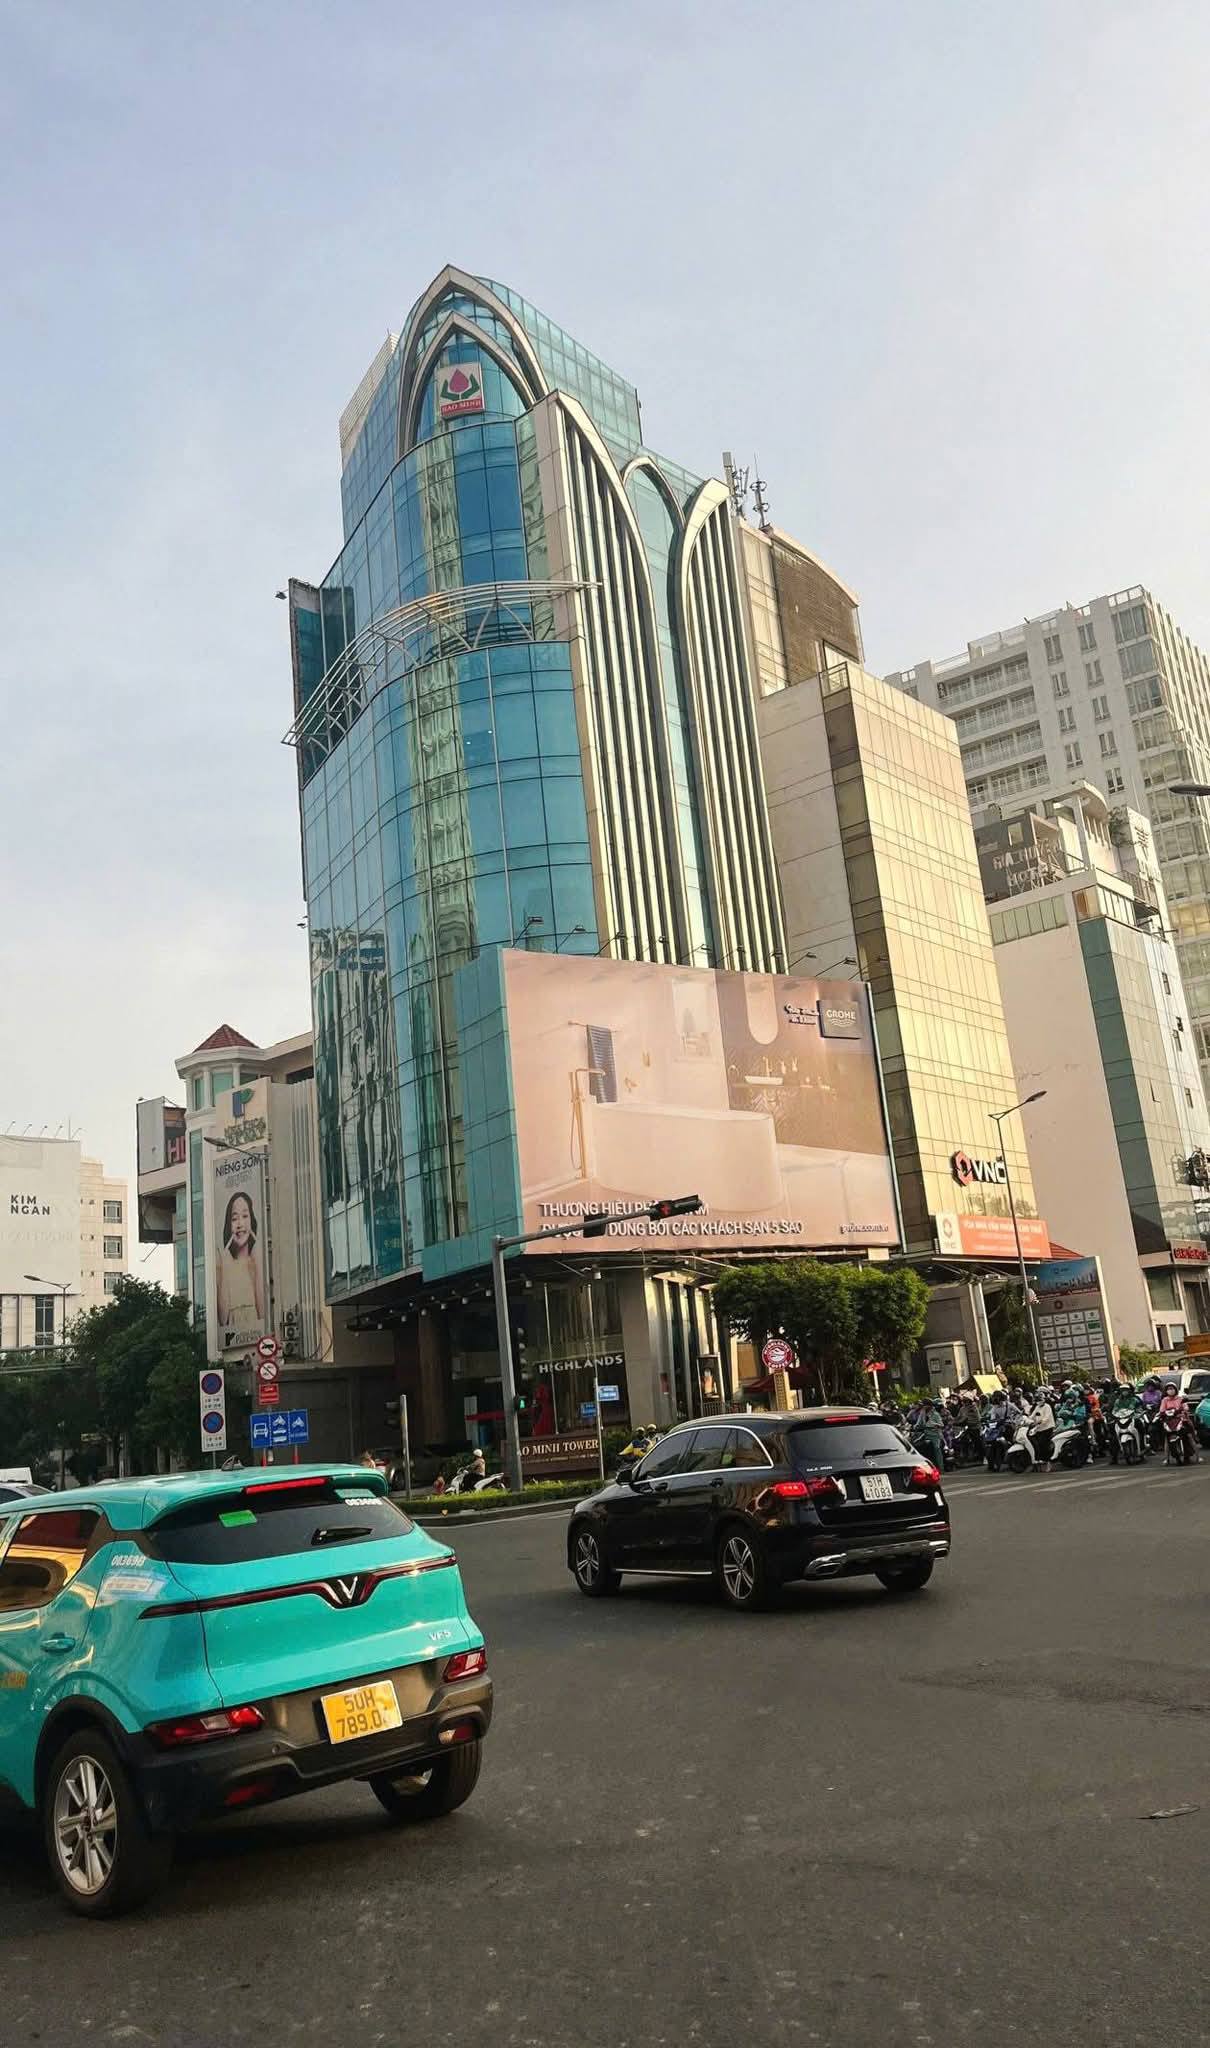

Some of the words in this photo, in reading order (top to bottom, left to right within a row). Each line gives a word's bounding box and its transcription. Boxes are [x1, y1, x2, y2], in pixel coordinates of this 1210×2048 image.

[826, 1009, 856, 1020] GROHE
[10, 1194, 37, 1205] KIM
[10, 1204, 50, 1216] NGAN
[609, 1219, 646, 1236] DÙNG
[671, 1217, 699, 1235] CÁC
[701, 1218, 742, 1235] KHÁCH
[743, 1221, 769, 1236] SẠN
[780, 1221, 803, 1234] SAO
[539, 1355, 623, 1373] HIGHLANDS
[533, 1443, 560, 1455] MINH
[562, 1440, 599, 1452] TOWER
[335, 1710, 389, 1738] 789.0
